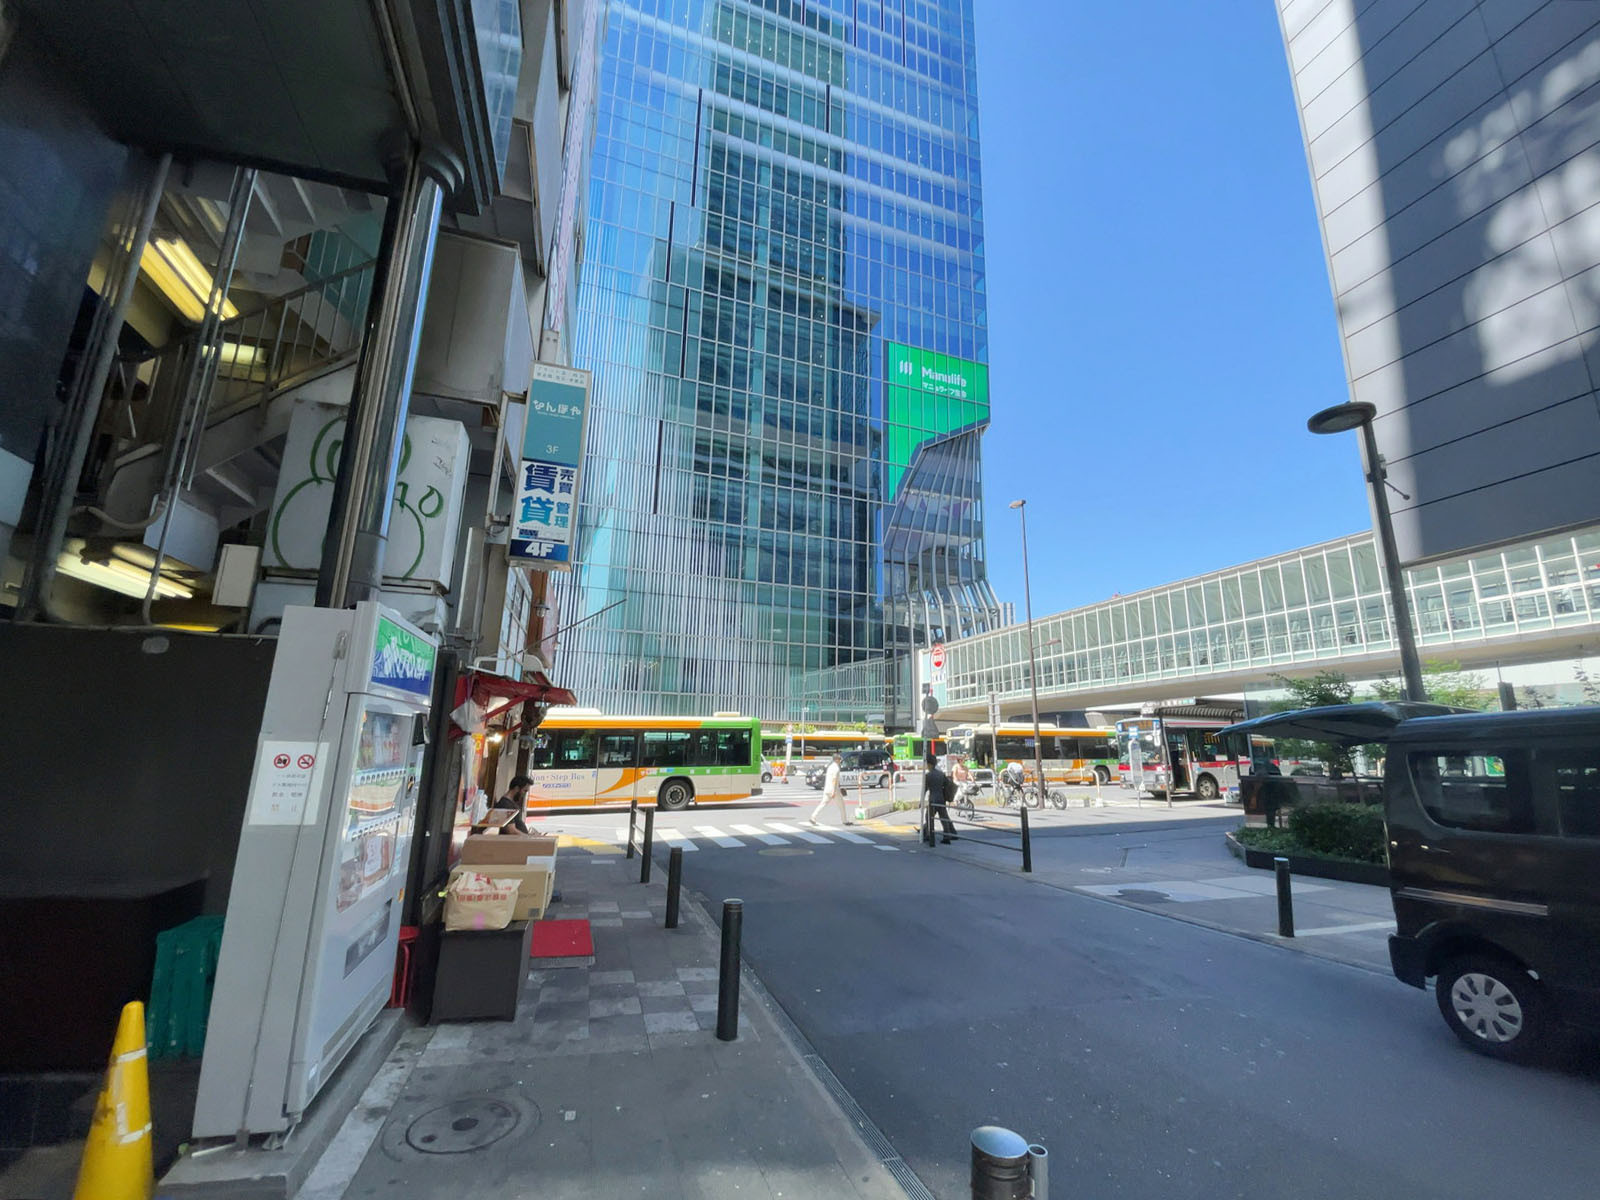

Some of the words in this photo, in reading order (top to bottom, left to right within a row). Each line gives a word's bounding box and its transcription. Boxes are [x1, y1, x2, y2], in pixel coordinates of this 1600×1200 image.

[921, 366, 967, 387] Manulife
[533, 400, 581, 416] なんぼや
[545, 445, 559, 454] 3F
[519, 463, 558, 527] 賃貸
[554, 501, 571, 528] 管理
[525, 541, 554, 557] 4F
[841, 775, 858, 783] TAXI
